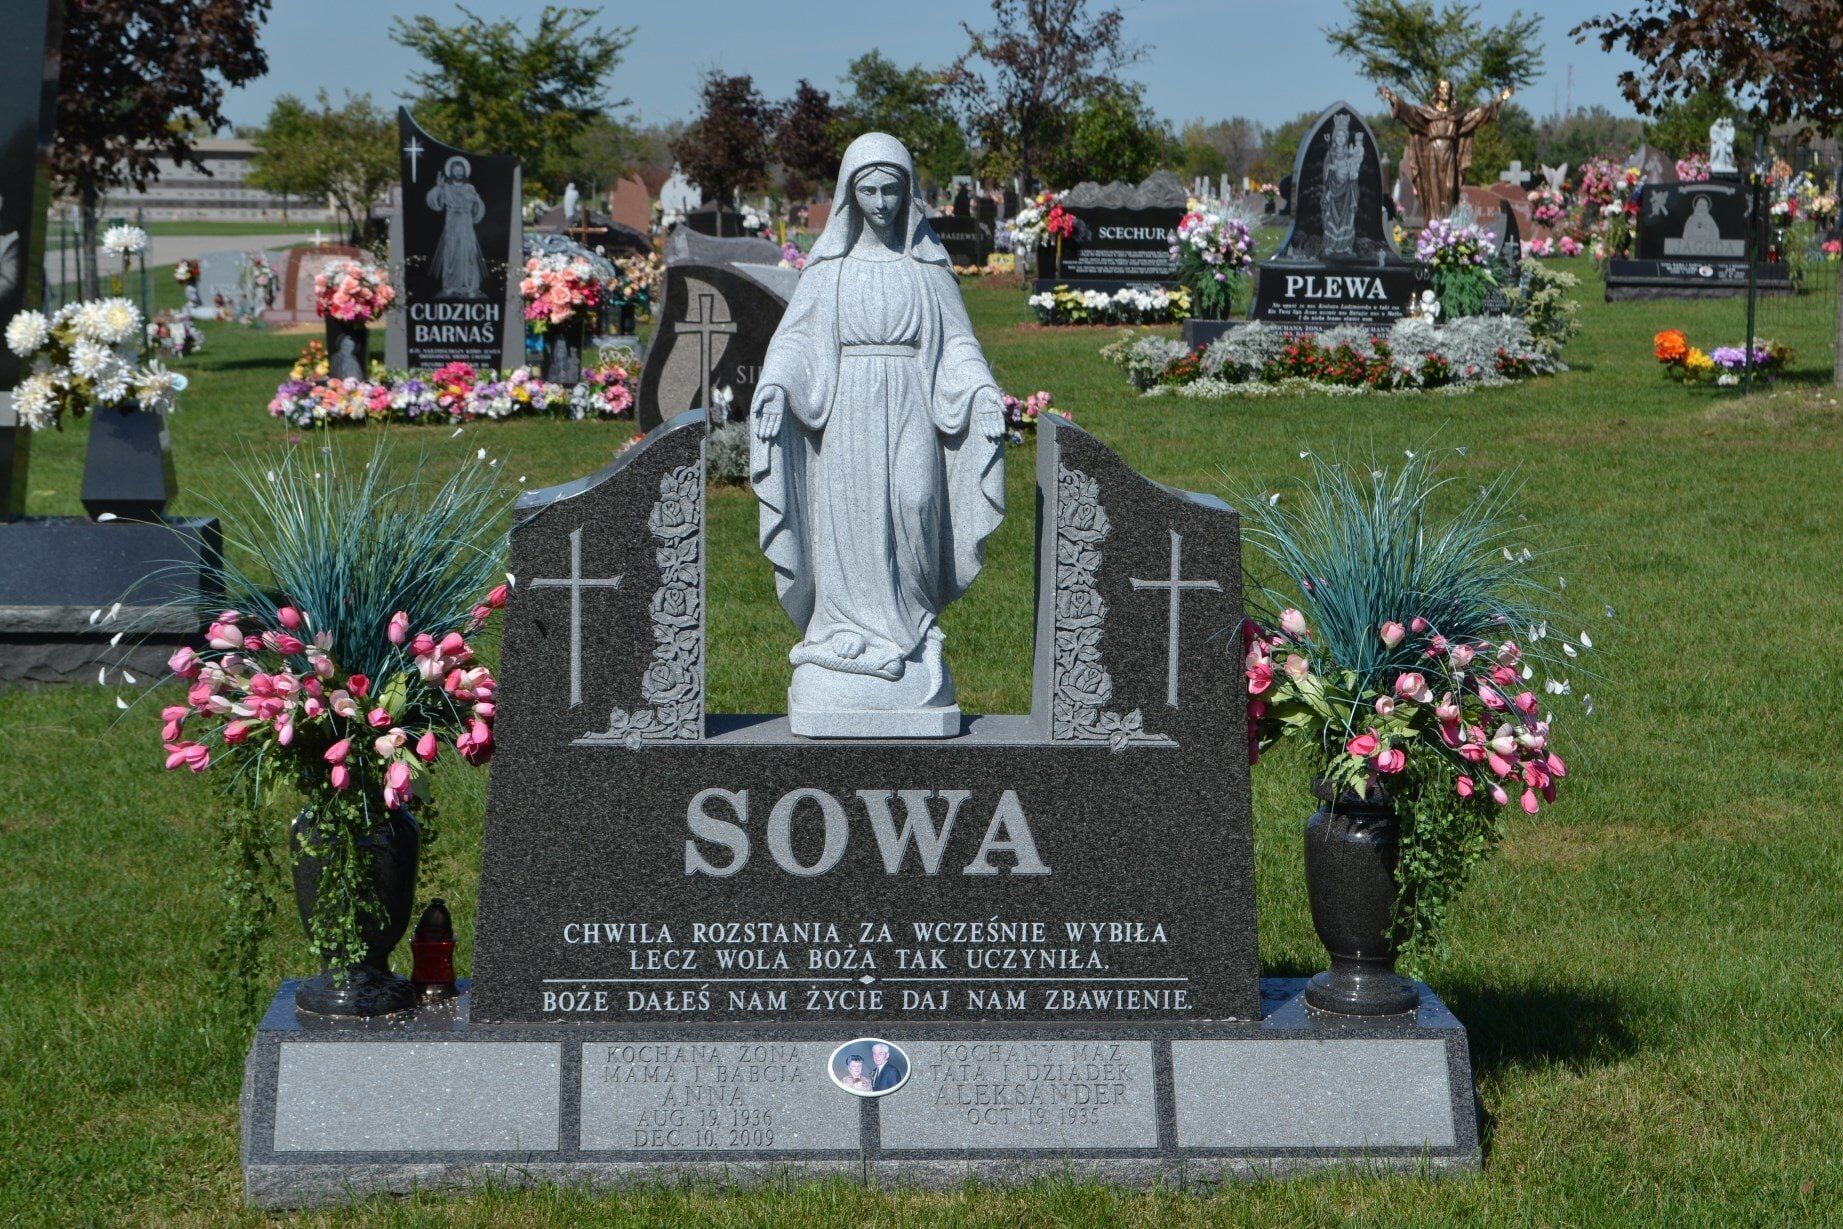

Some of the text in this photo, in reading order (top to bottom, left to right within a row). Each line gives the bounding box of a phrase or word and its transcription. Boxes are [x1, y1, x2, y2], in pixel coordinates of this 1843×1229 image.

[1672, 240, 1735, 255] JAGODA
[1284, 275, 1387, 299] PLEWA
[410, 303, 499, 321] CUDZICH
[415, 322, 495, 343] BARNAŚ
[684, 787, 1053, 878] SOWA
[563, 915, 1168, 944] CHWILA ROZSTANIA ZA WCZEŚNIE WYBIŁA
[630, 943, 1109, 970] LECZ WOLA BOŻA TAK UCZYNIŁA.
[542, 983, 1193, 1012] BOŻE DAŁEŚ NAM ŻYCIE DAJ NAM ZBAWIENIE.
[606, 1046, 723, 1063] KOCHANA
[939, 1044, 1056, 1062] KOCHANY
[603, 1065, 805, 1083] MAMA I BABCIA
[929, 1064, 1135, 1082] TATA I DZIADEK
[661, 1085, 747, 1107] ANNA
[933, 1083, 1131, 1106] ALEKSANDER
[636, 1109, 689, 1127] AUG.
[732, 1109, 773, 1127] 1936
[1060, 1107, 1100, 1125] 1935
[634, 1129, 684, 1147] DEC.
[729, 1129, 775, 1147] 2009
